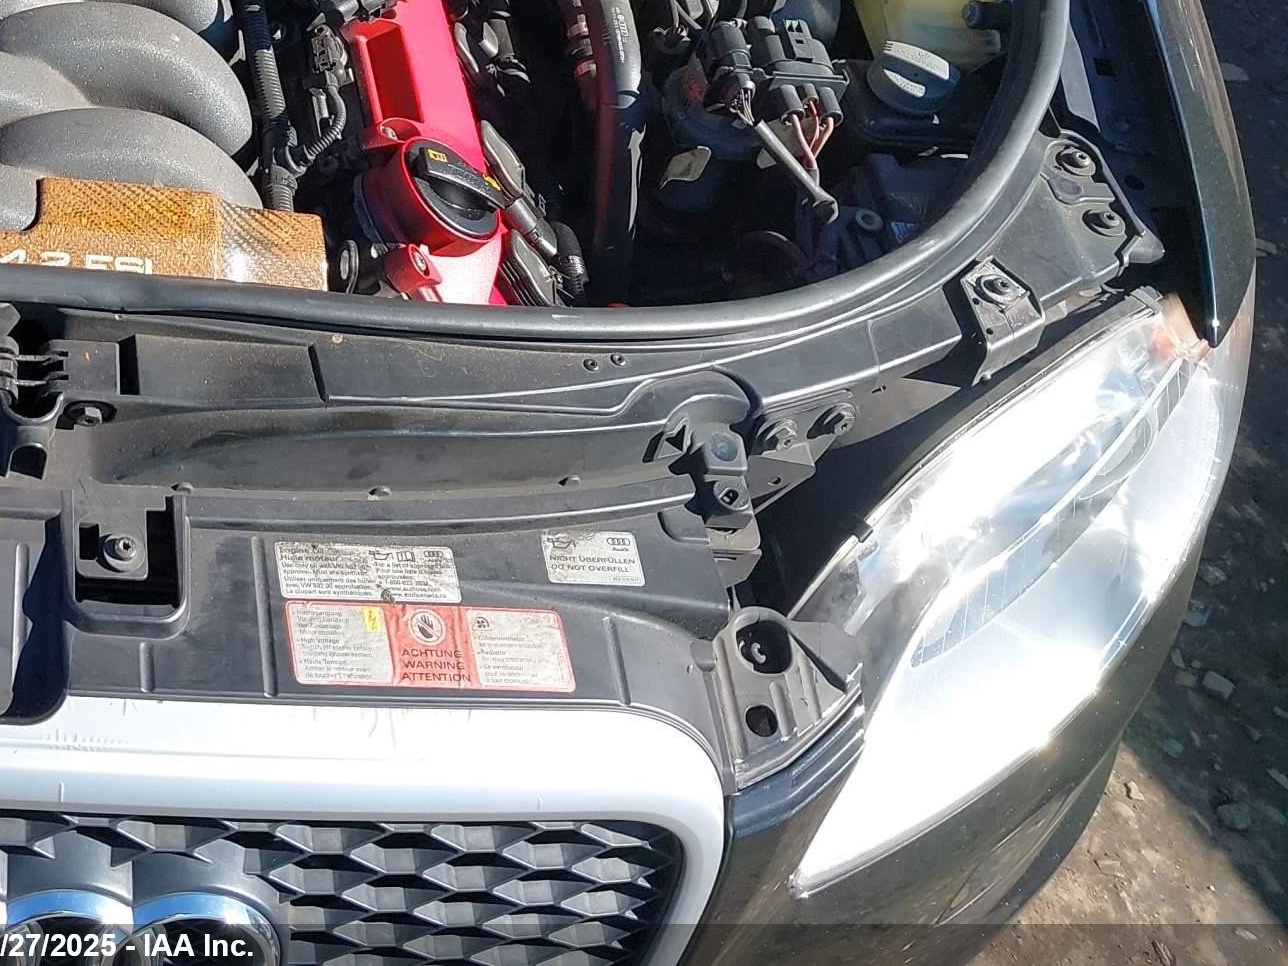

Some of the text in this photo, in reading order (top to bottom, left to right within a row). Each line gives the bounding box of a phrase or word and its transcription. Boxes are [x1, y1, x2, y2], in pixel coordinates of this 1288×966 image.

[549, 555, 577, 563] NICHT
[588, 565, 630, 573] OVERFILL
[402, 648, 463, 659] ACHTUNG
[402, 660, 465, 670] WARNING
[402, 672, 472, 683] ATTENTION
